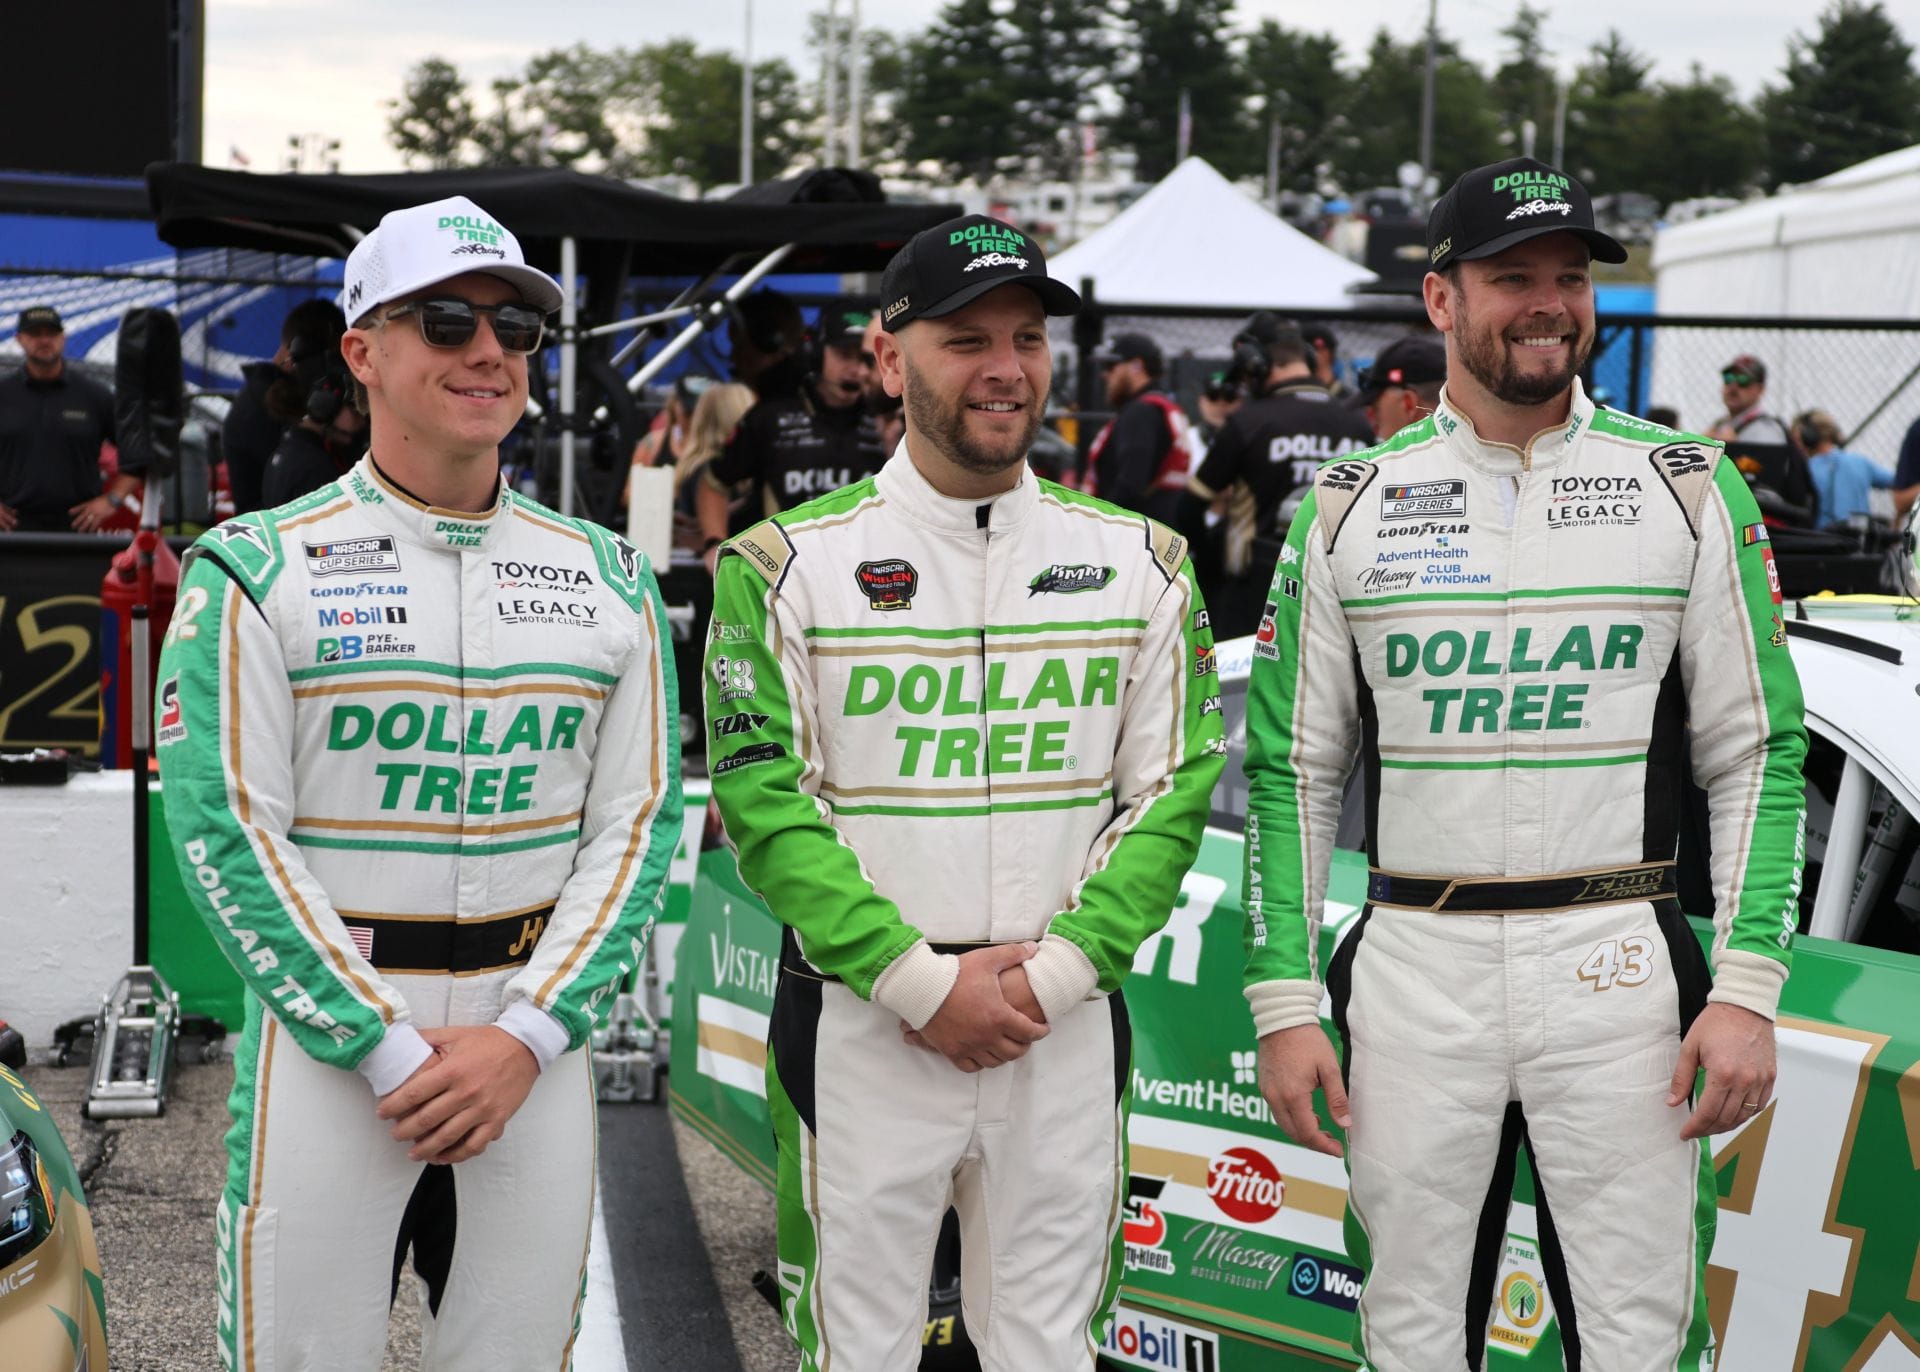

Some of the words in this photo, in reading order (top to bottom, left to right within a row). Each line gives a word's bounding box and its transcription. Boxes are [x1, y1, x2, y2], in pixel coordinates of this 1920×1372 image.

[1493, 171, 1570, 192] DOLLAR
[1511, 186, 1564, 201] TREE
[1526, 199, 1573, 216] Racing
[438, 216, 504, 238] DOLLAR
[950, 224, 1026, 247] DOLLAR
[455, 229, 498, 246] TREE
[471, 243, 506, 260] Racing
[968, 239, 1020, 254] TREE
[986, 252, 1029, 270] Racing
[885, 295, 910, 319] LEGACY
[1606, 415, 1650, 432] DOLLAR
[1671, 463, 1710, 478] SIMPSON
[1409, 484, 1452, 497] NASCAR
[1552, 477, 1642, 494] TOYOTA
[1394, 500, 1416, 511] CUP
[1416, 498, 1453, 510] SERIES
[1552, 494, 1638, 503] RACING
[1548, 504, 1642, 521] LEGACY
[1377, 522, 1469, 538] GOODYEAR
[1563, 519, 1597, 527] MOTOR
[332, 540, 381, 553] NASCAR
[446, 534, 482, 547] TREE
[319, 558, 344, 570] CUP
[344, 555, 384, 567] SERIES
[874, 564, 906, 574] NASCAR
[1427, 565, 1461, 573] CLUB
[491, 562, 594, 585] TOYOTA
[861, 571, 912, 584] WHELEN
[1050, 565, 1104, 580] KMM
[1357, 567, 1417, 588] Massey
[1420, 574, 1491, 585] WYNDHAM
[310, 583, 409, 598] GOODYEAR
[497, 581, 595, 594] RACING
[318, 607, 382, 627] Mobil
[498, 600, 598, 619] LEGACY
[519, 616, 555, 624] MOTOR
[557, 617, 581, 626] CLUB
[366, 644, 415, 653] BARKER
[1386, 624, 1644, 677] DOLLAR
[843, 657, 1119, 717] DOLLAR
[1422, 684, 1589, 733] TREE
[327, 702, 584, 755] DOLLAR
[714, 711, 771, 742] FURY
[895, 721, 1070, 778] TREE
[375, 763, 538, 814] TREE
[1249, 814, 1263, 901] DOLLAR
[184, 838, 279, 976] DOLLAR
[508, 916, 545, 956] JH
[1577, 936, 1654, 992] 43
[271, 974, 357, 1048] TREE
[1207, 1153, 1287, 1208] Fritos
[1183, 1222, 1290, 1290] Massey
[1515, 1247, 1535, 1261] TREE
[1191, 1266, 1221, 1283] MOTOR
[1224, 1271, 1264, 1291] FREIGHT
